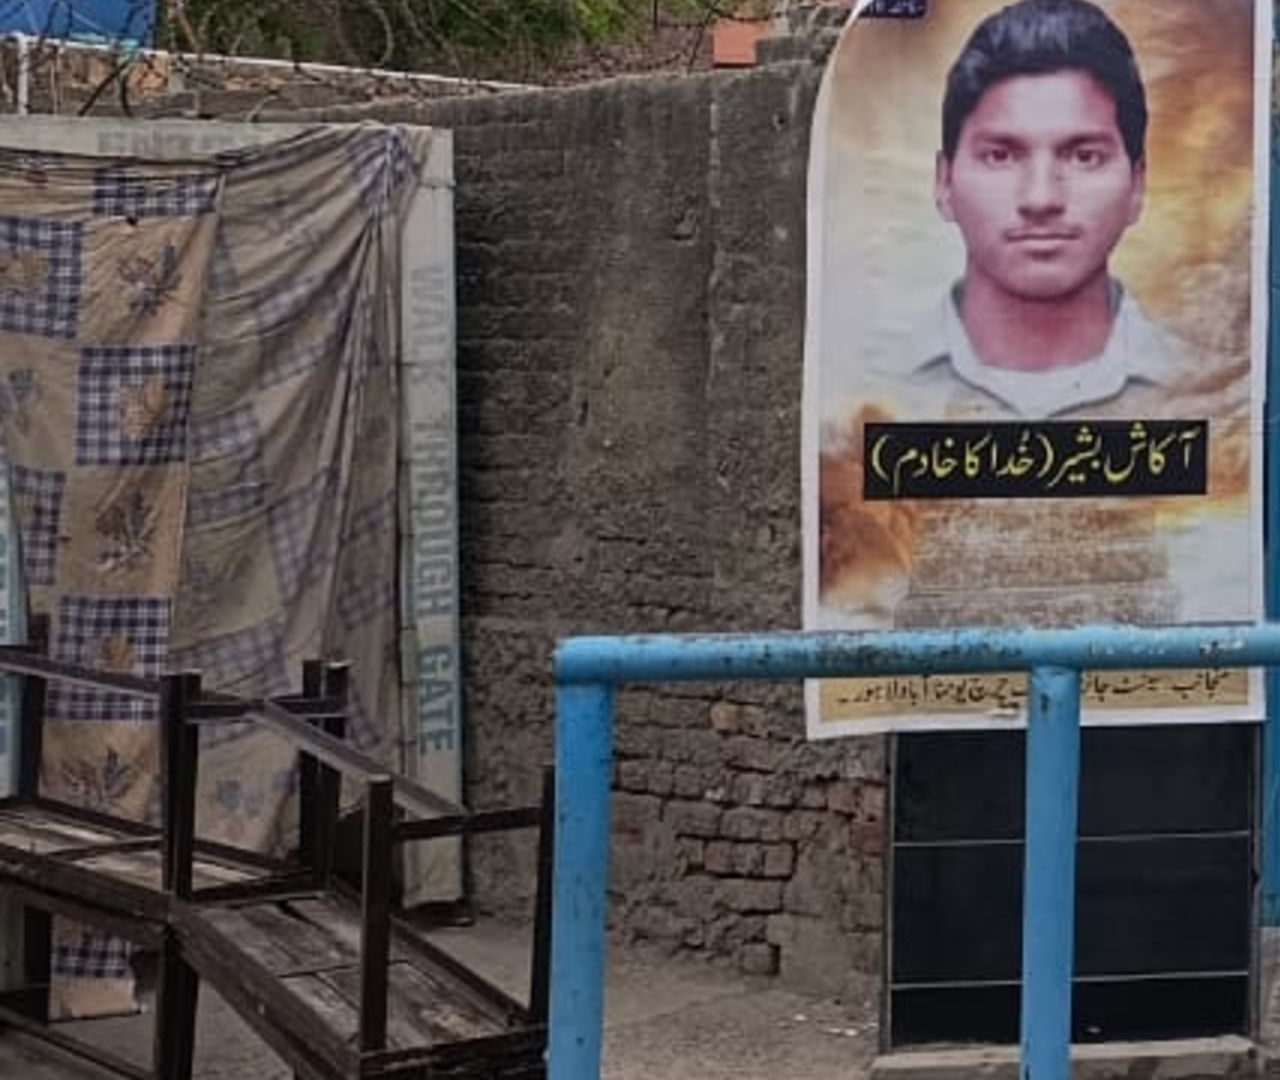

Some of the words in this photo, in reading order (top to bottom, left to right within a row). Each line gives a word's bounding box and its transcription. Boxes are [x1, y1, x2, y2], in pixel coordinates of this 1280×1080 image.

[408, 266, 447, 387] WALK
[964, 430, 994, 478] کا
[1046, 424, 1102, 489] بشیر
[412, 416, 454, 616] THROUGH
[417, 644, 457, 753] GATE
